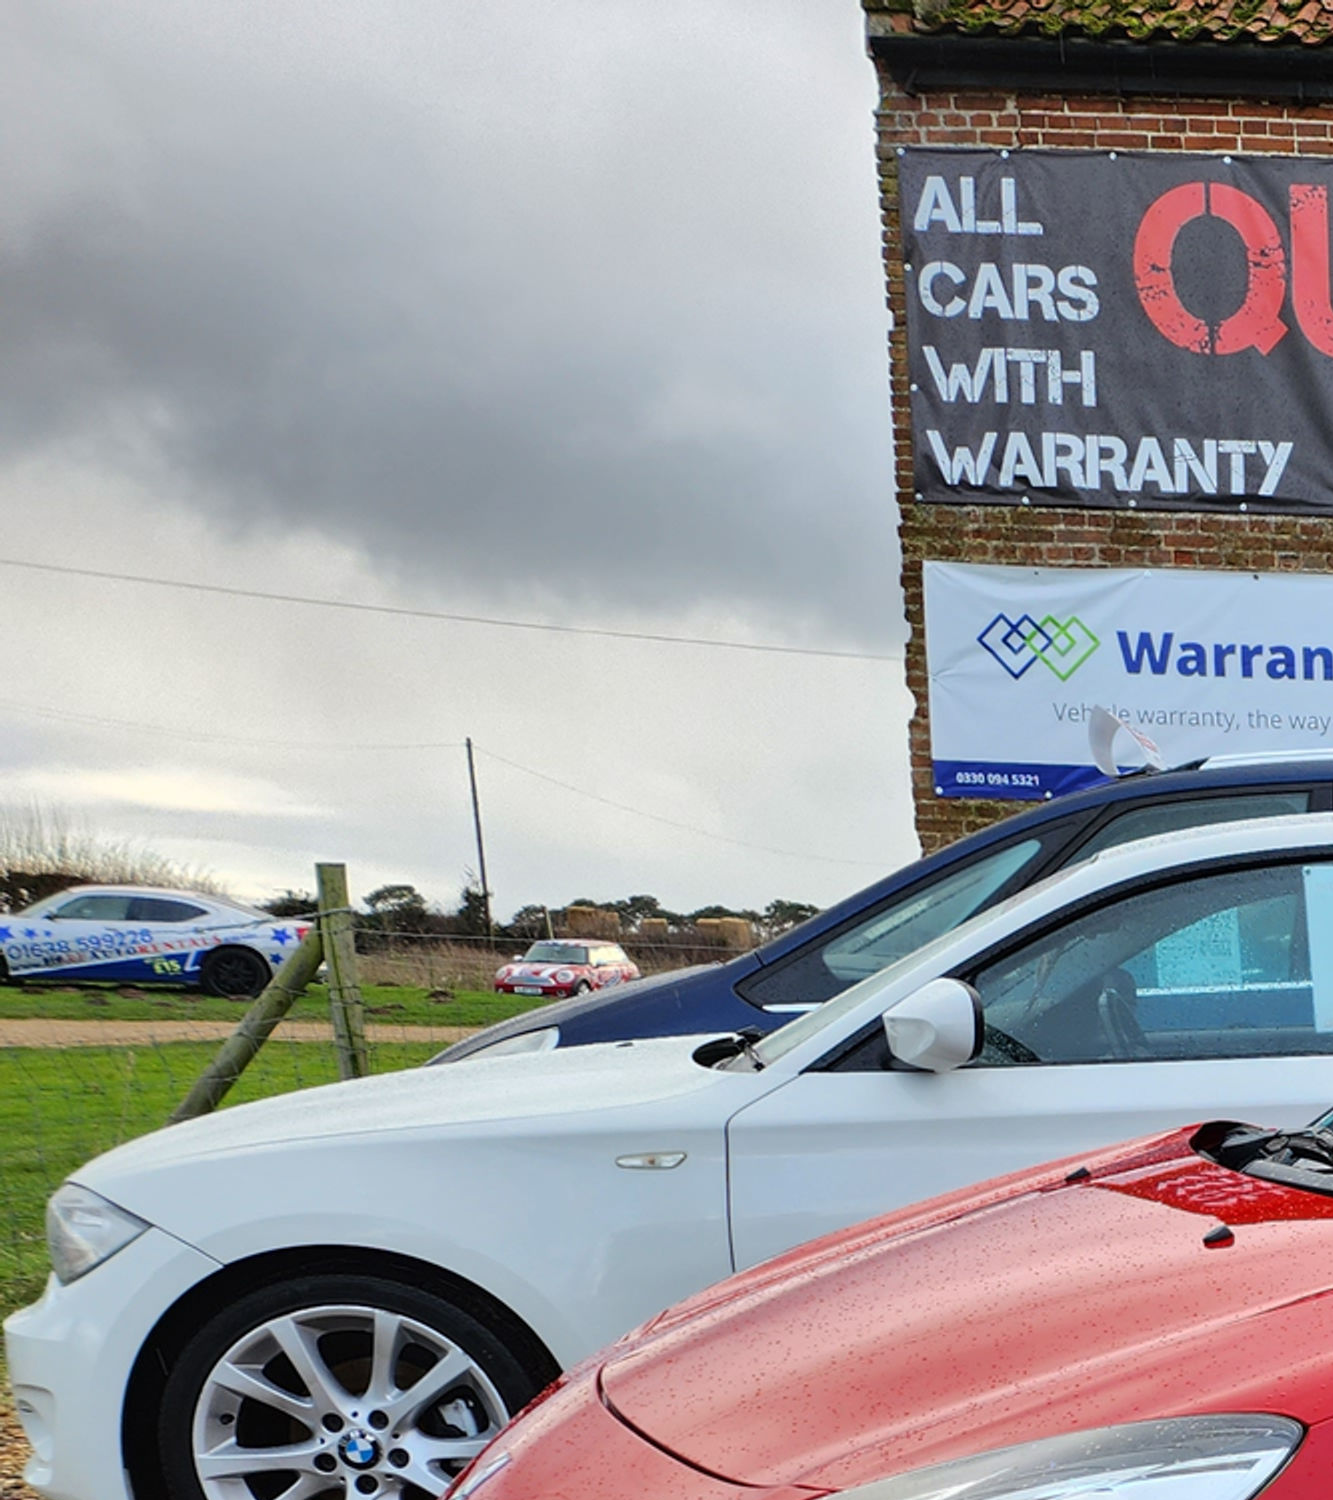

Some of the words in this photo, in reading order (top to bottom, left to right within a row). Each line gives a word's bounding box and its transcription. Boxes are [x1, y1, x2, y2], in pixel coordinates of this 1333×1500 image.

[913, 174, 1044, 237] ALL
[917, 260, 1101, 323] CARS
[921, 345, 1097, 407] WITH
[926, 428, 1294, 496] WARRANTY
[1053, 702, 1131, 723] Vehle
[1136, 709, 1240, 733] warranty,
[1247, 709, 1283, 729] the
[1288, 714, 1332, 737] way
[955, 771, 986, 785] 0330
[986, 773, 1010, 786] 094
[1011, 773, 1040, 787] 5321
